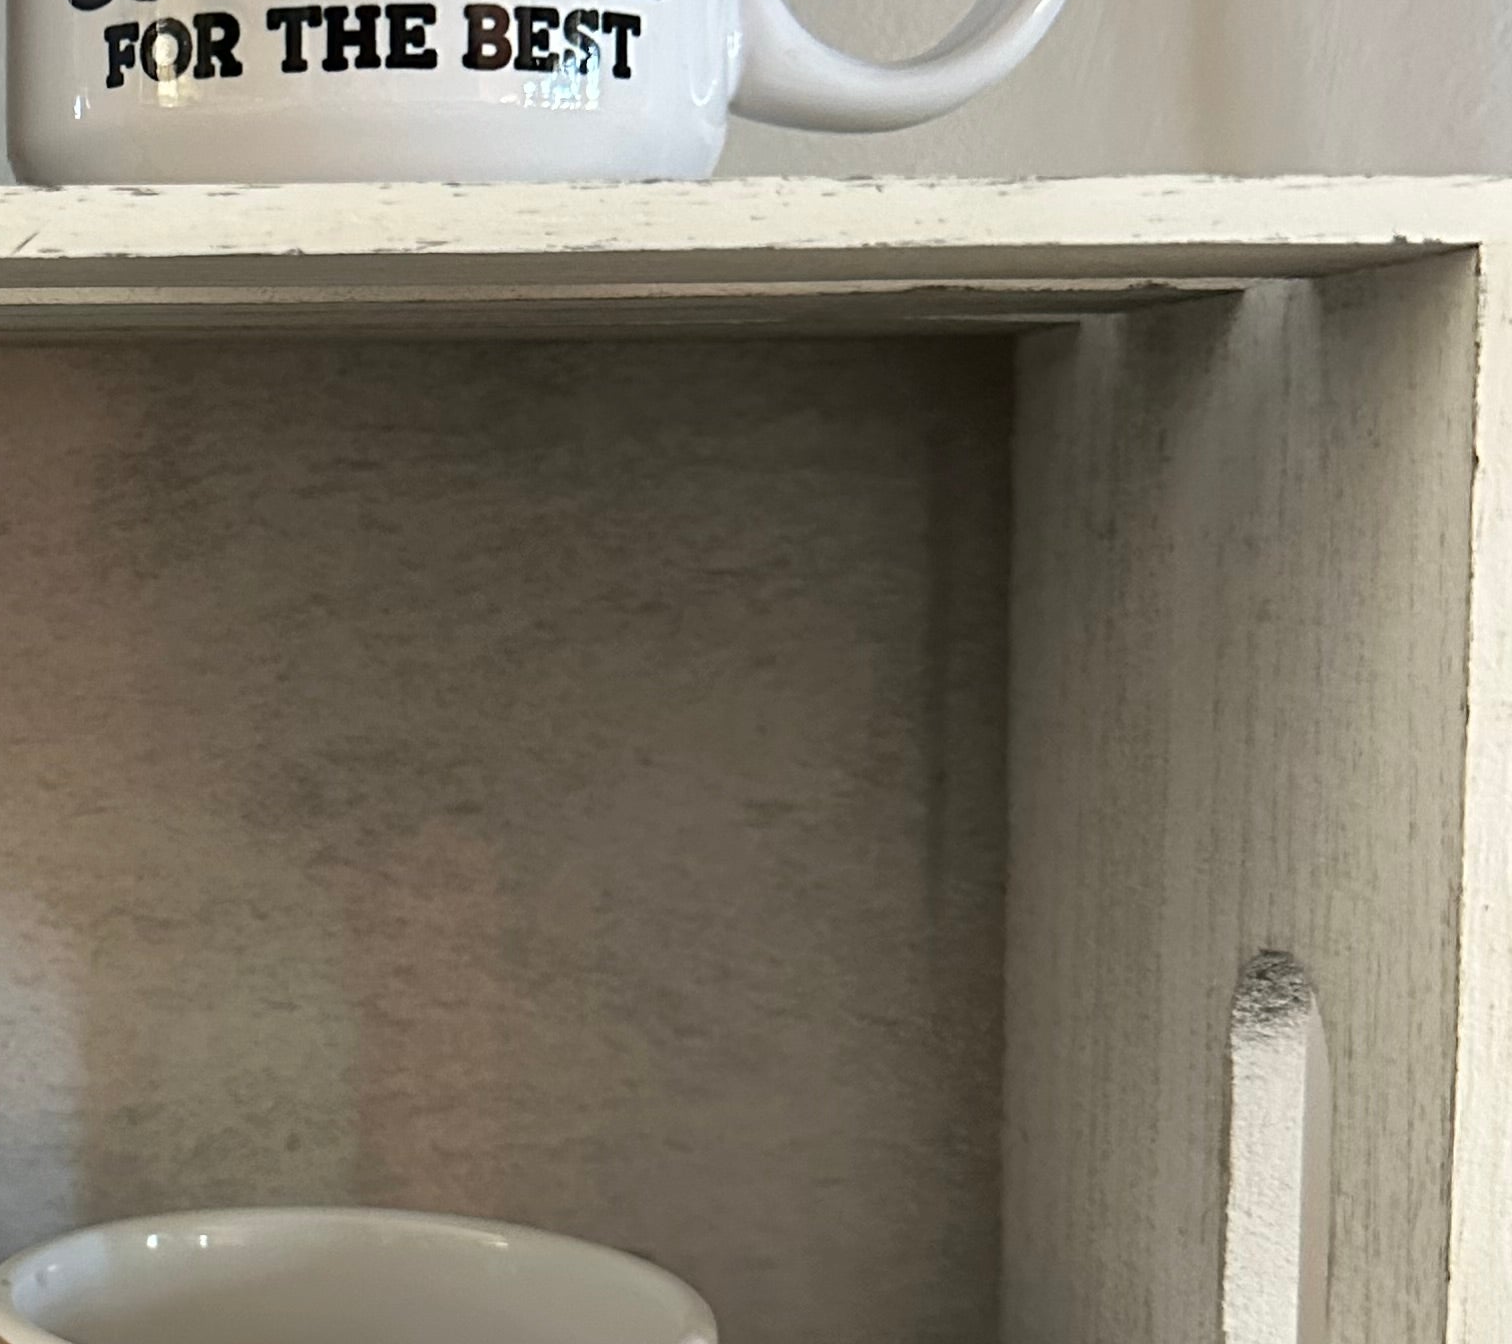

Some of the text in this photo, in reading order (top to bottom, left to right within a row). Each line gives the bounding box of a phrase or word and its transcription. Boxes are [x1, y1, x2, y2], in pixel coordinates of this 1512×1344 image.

[105, 3, 642, 89] FOR THE BEST
